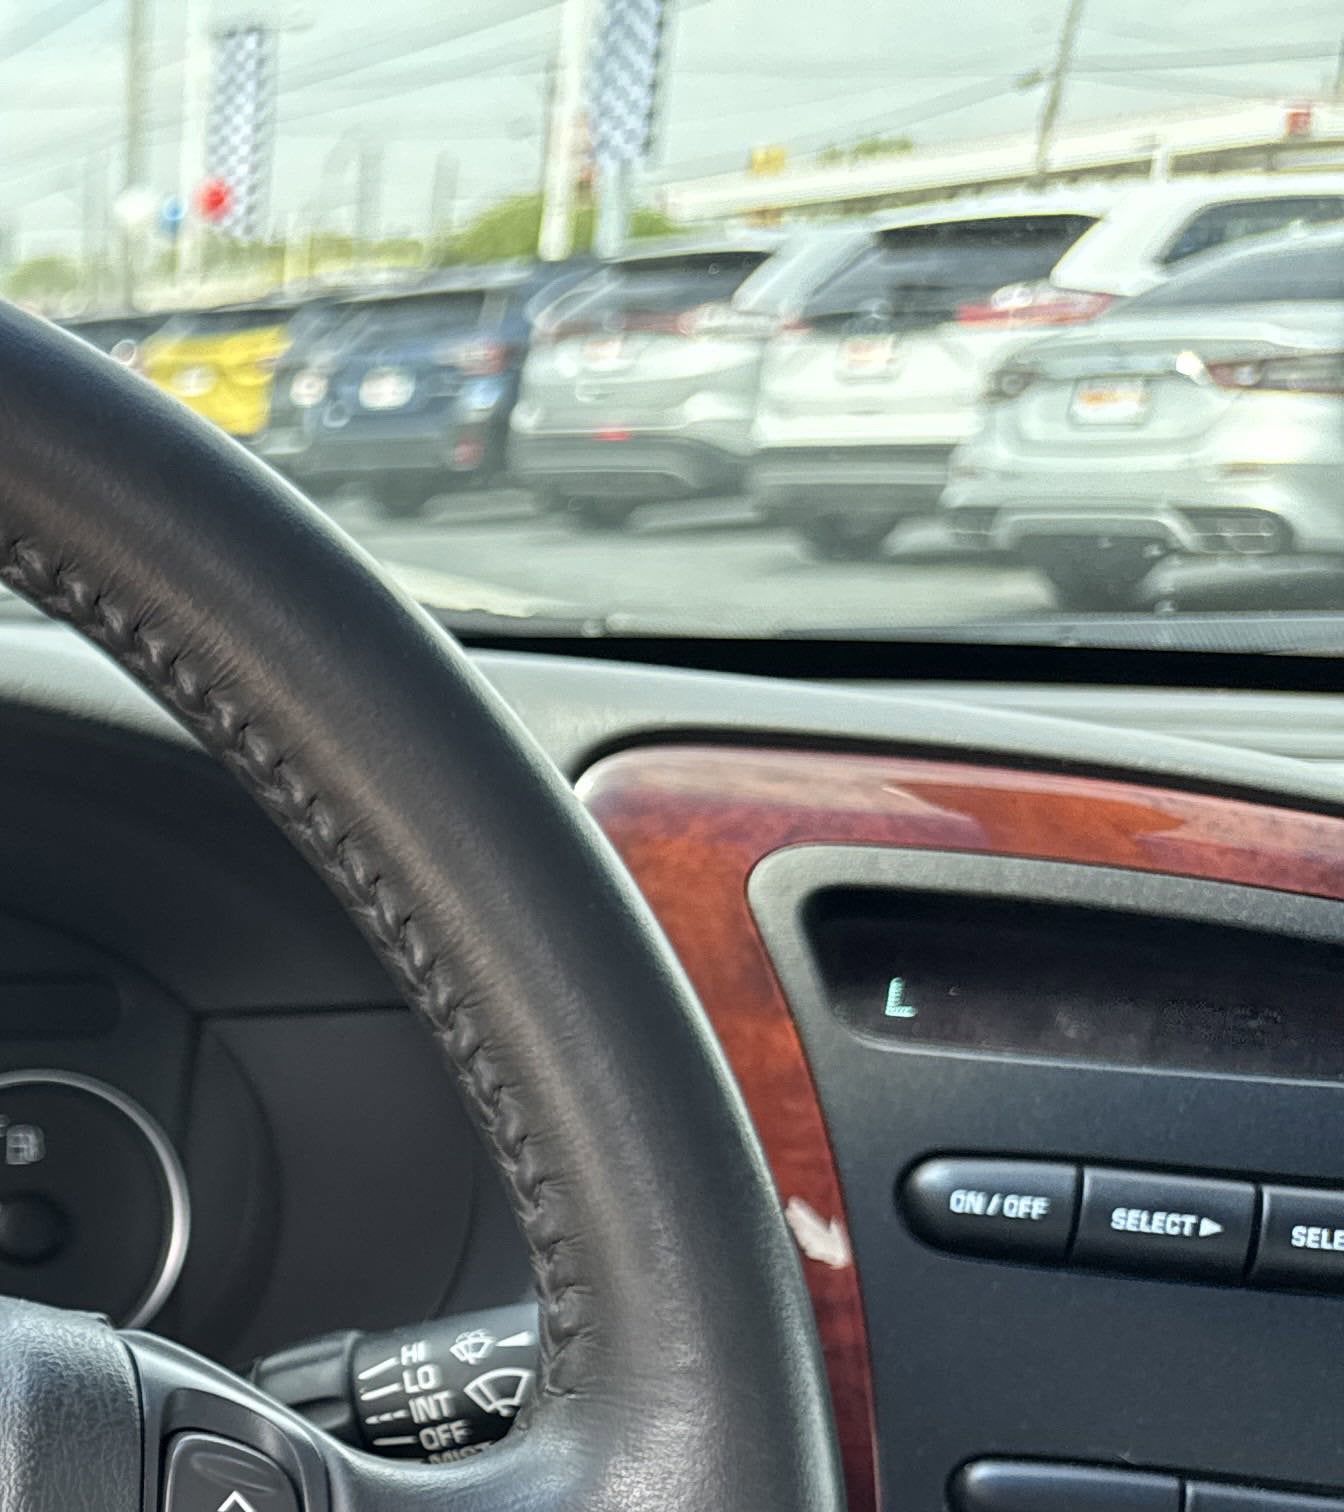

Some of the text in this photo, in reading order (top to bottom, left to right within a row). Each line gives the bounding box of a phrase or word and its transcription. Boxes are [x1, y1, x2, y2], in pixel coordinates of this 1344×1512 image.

[1111, 1207, 1199, 1237] SELECT
[401, 1340, 431, 1366] HI
[402, 1364, 443, 1394] LO
[408, 1390, 456, 1424] INT
[418, 1419, 471, 1451] OFF
